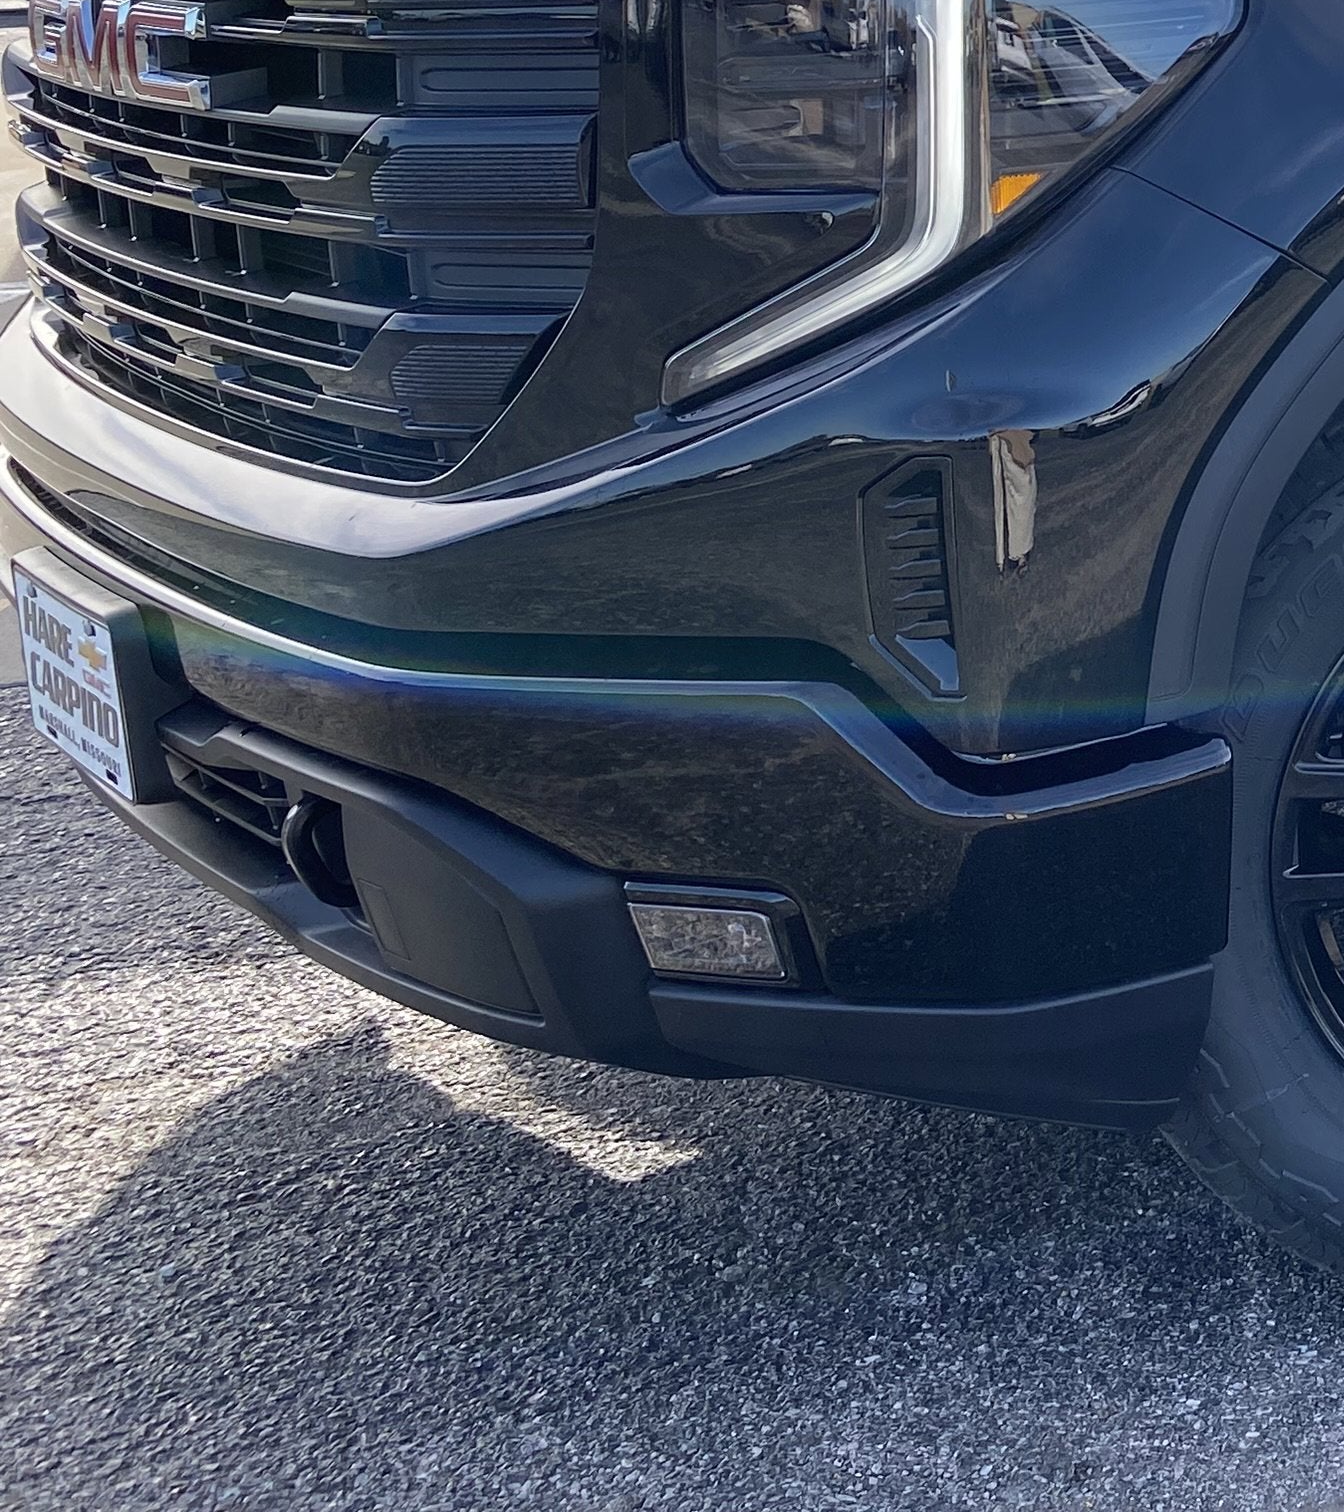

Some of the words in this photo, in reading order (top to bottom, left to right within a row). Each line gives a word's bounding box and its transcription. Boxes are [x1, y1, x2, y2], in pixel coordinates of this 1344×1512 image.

[22, 595, 75, 668] HARE
[30, 651, 120, 748] CARPINO
[81, 737, 122, 777] MISSOURI
